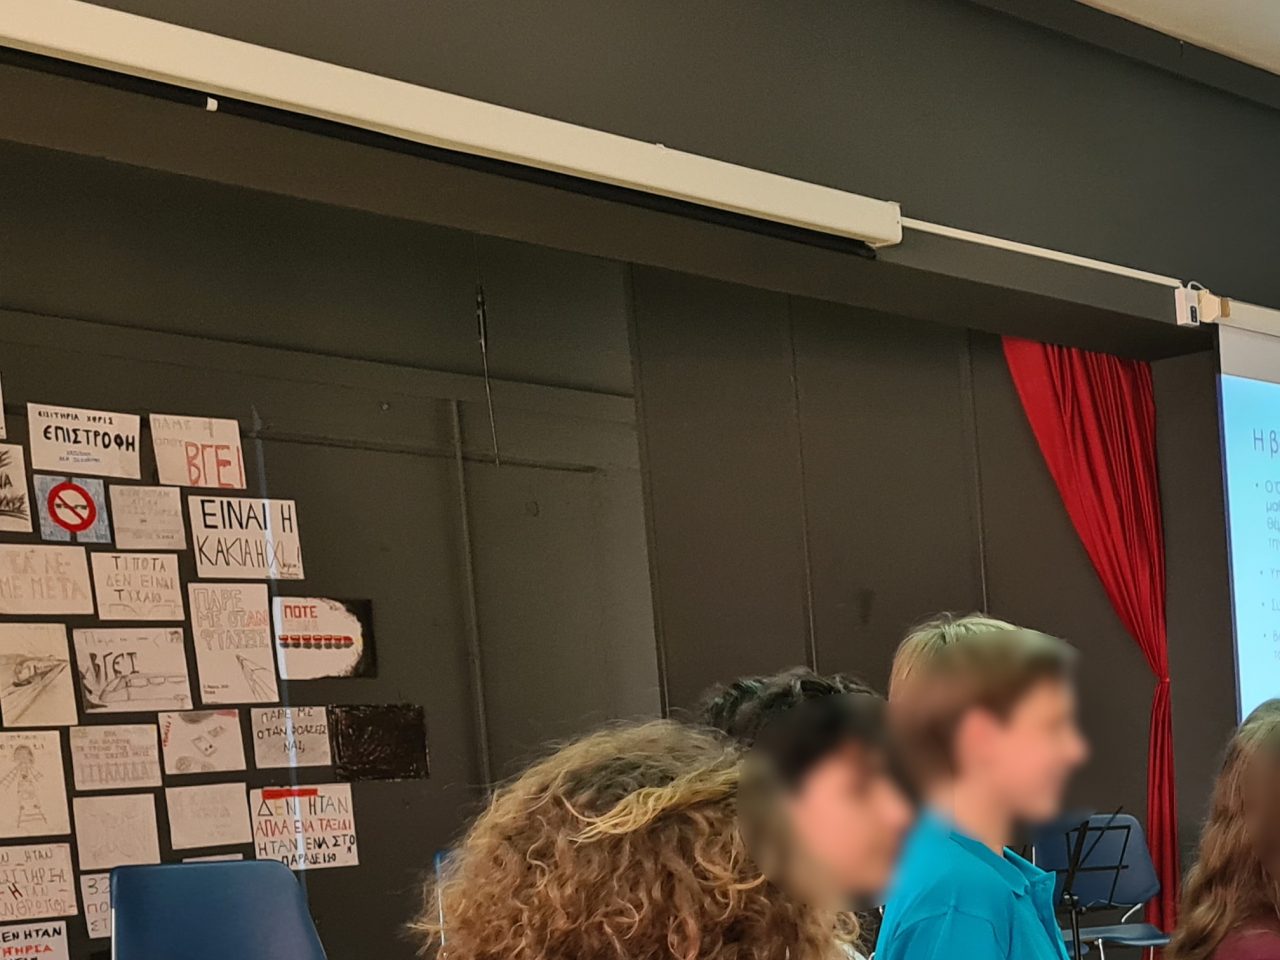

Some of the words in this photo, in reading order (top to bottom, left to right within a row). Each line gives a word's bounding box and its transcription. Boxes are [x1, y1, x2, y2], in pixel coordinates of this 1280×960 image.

[43, 424, 135, 452] ΕΠΙΣΤΡΟΦΗ
[1252, 428, 1265, 451] Η
[185, 440, 244, 489] ΒΓΕΙ
[200, 498, 269, 531] ΕΙΝΑΙ
[280, 502, 293, 533] Η
[110, 555, 167, 572] ΤΙΠΟΤΑ
[140, 574, 175, 590] ΕΙΝΑΙ
[193, 588, 244, 612] ΠΑΡΕ
[283, 604, 319, 619] ΠΟΤΕ
[257, 798, 297, 817] ΔΕΝ
[308, 795, 349, 816] ΗΤΑΝ
[257, 838, 298, 856] ΗΤΑΝ
[305, 835, 330, 851] ΕΝΑ
[0, 931, 20, 943] ΕΝ
[24, 926, 62, 940] ΗΤΑΝ
